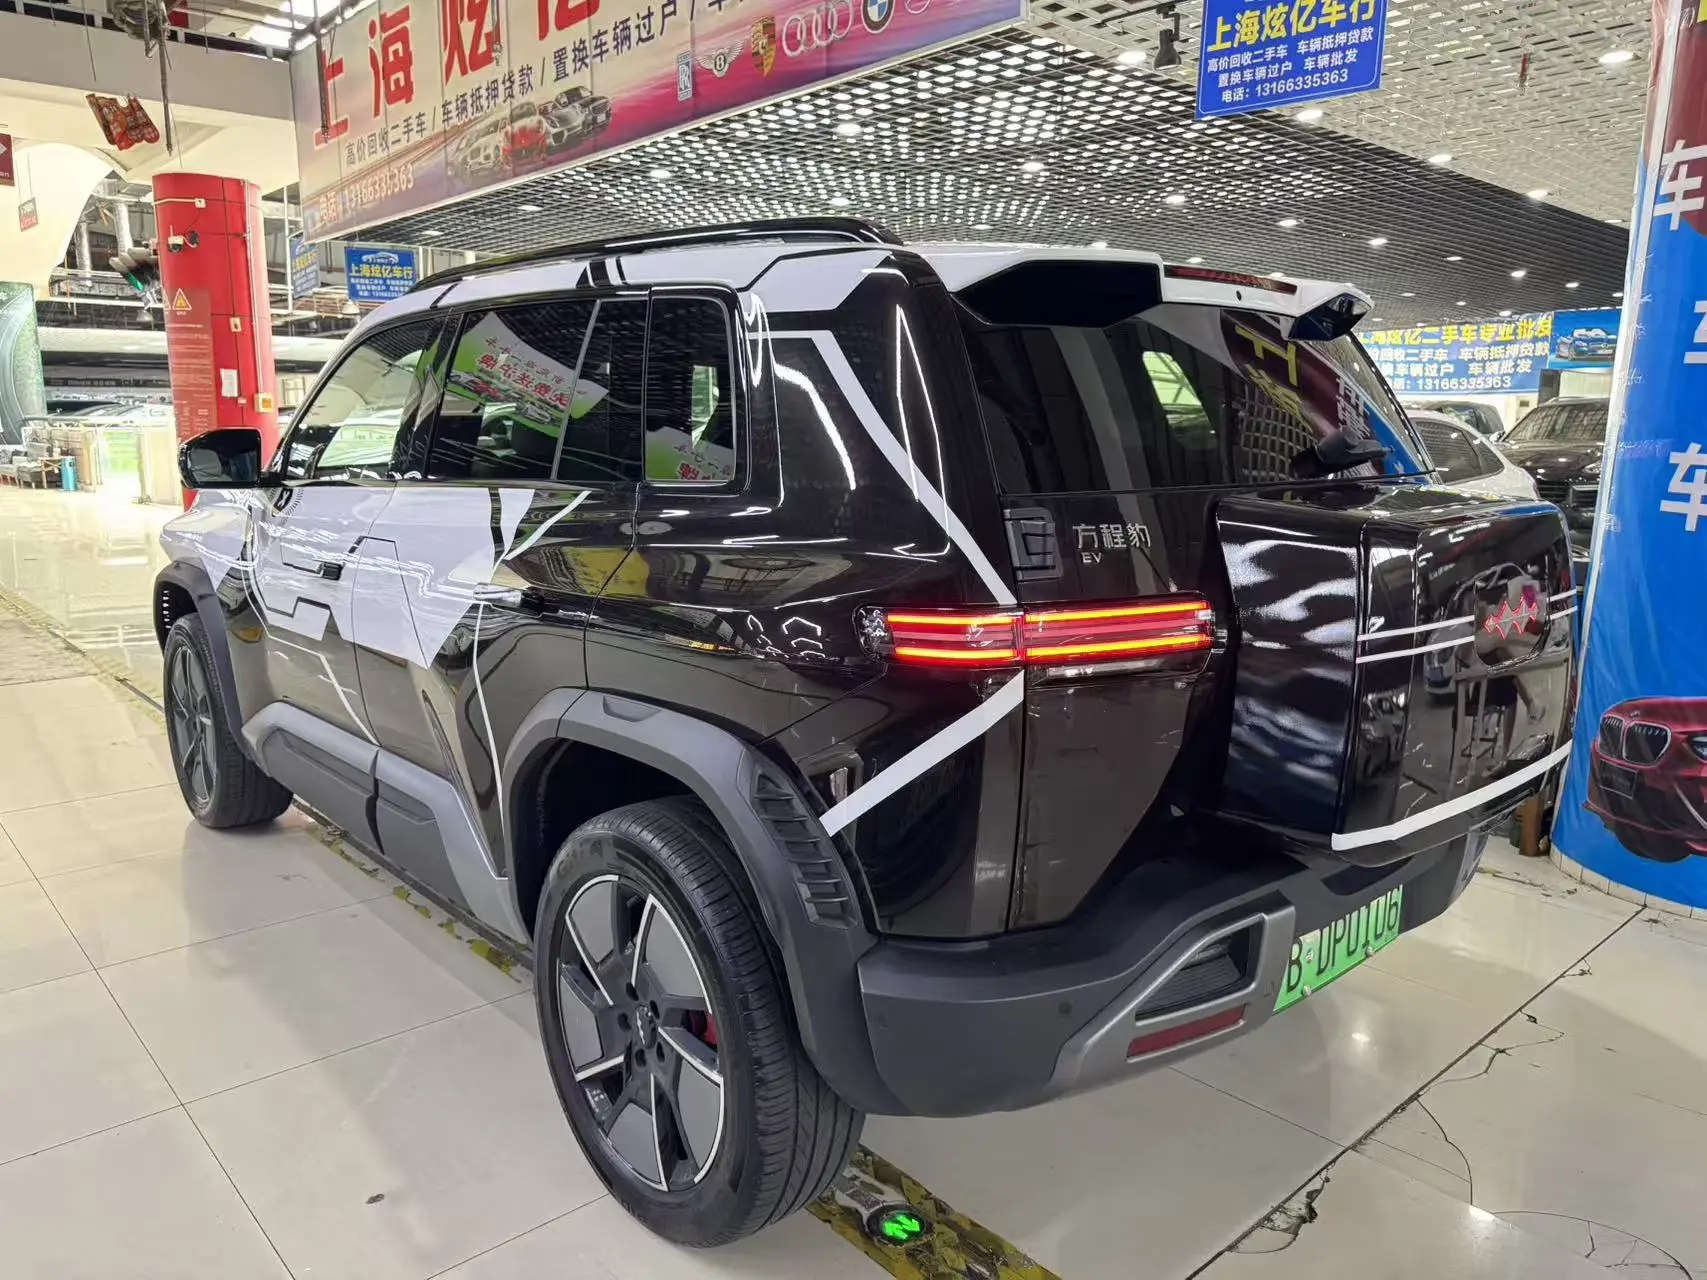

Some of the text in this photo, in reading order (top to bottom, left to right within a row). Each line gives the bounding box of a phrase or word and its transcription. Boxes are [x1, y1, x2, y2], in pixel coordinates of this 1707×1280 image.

[1207, 27, 1374, 73] 高价回收二手车 车辆抵押贷款
[1218, 48, 1359, 88] 置换车辆过户 车辆批发
[1072, 523, 1151, 549] 方程豹
[1081, 551, 1102, 564] EV
